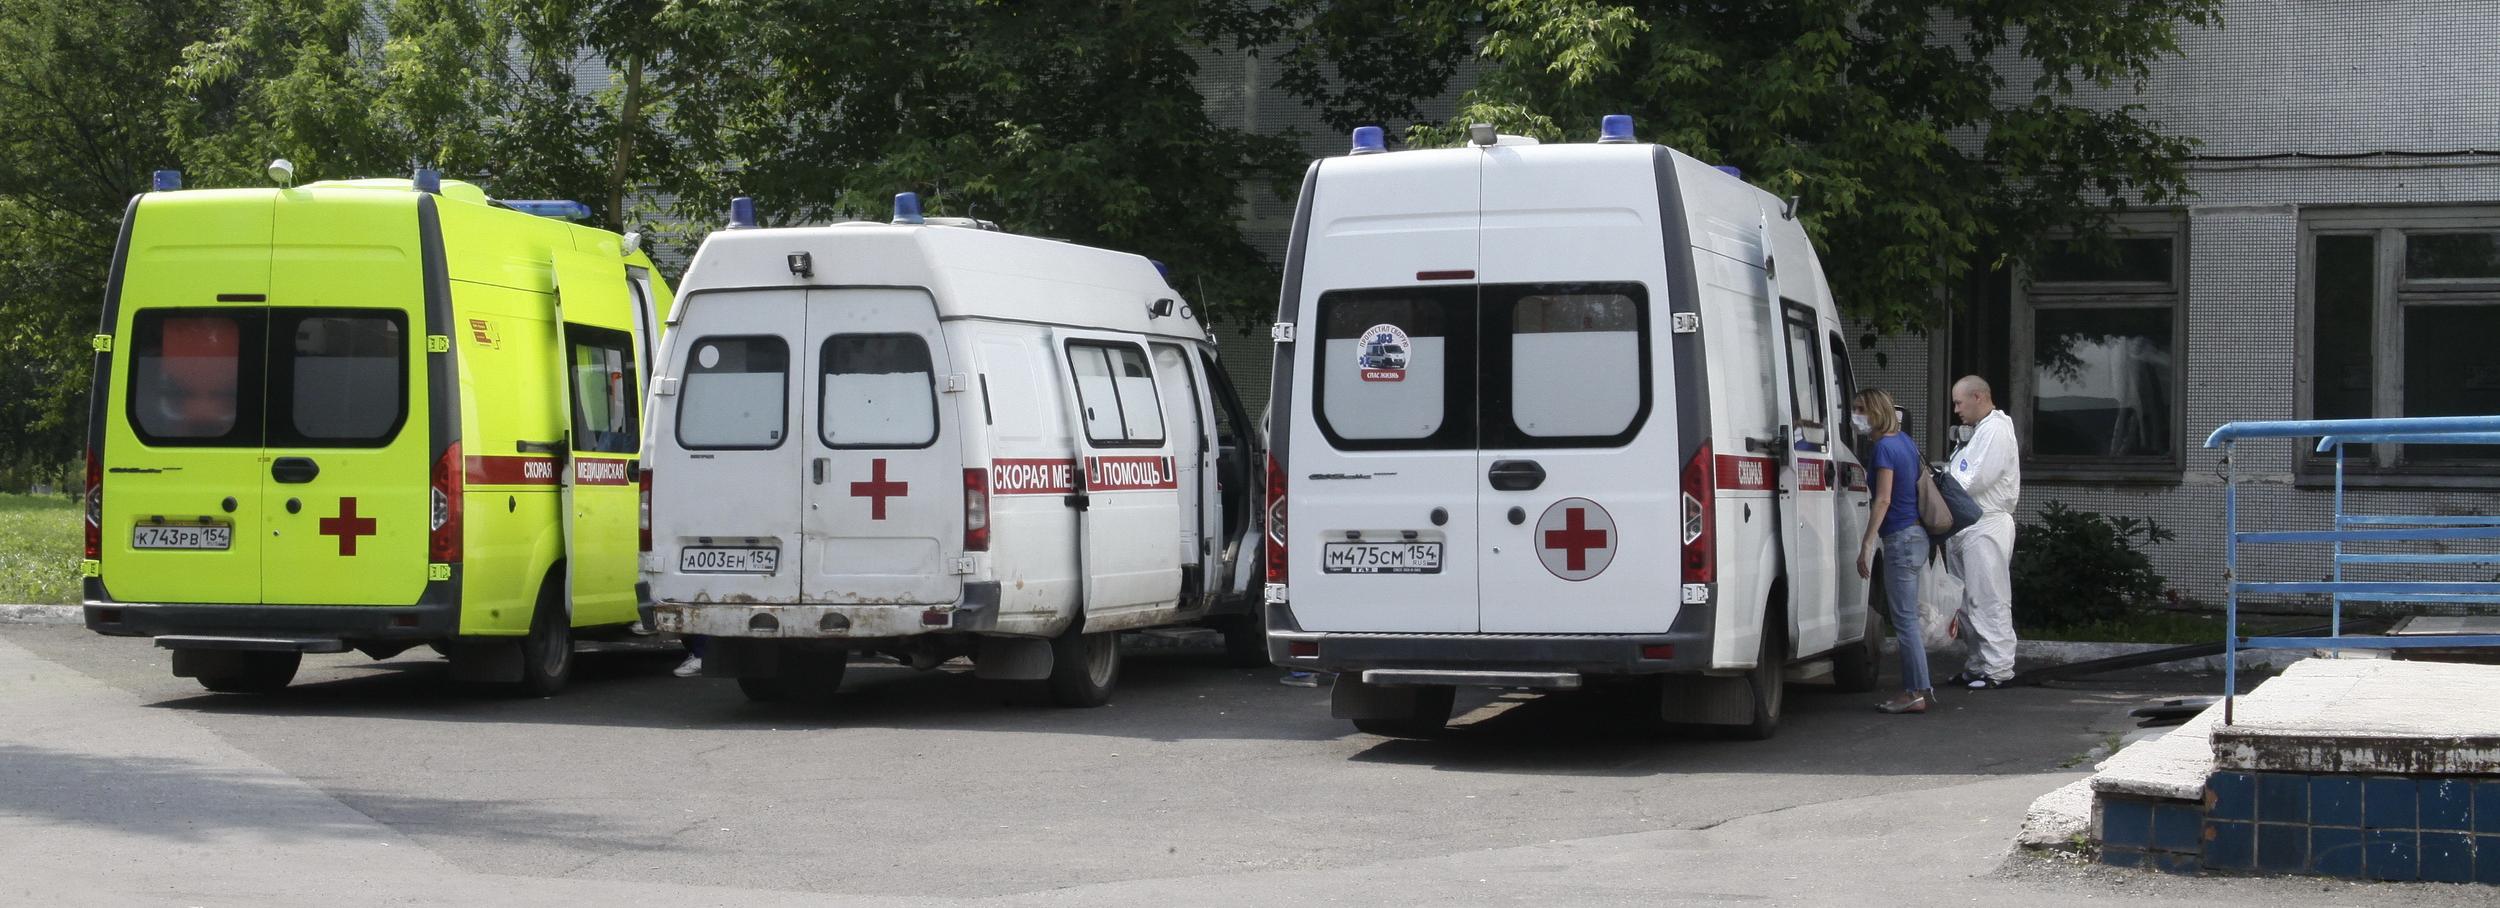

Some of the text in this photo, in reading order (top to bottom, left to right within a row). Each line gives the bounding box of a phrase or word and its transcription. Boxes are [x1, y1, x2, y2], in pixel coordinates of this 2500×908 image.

[1376, 333, 1393, 344] 103
[524, 461, 624, 482] СКОРАЯ МЕДИЦИНСКАЯ
[994, 464, 1074, 490] СКОРАЯ МЕ
[1103, 461, 1160, 487] ПОМОЩЬ
[1738, 460, 1764, 485] СКОРАЯ
[139, 528, 226, 546] К743РВ 154
[687, 551, 774, 568] А003ЕН 154
[1331, 545, 1435, 565] М475СМ 154
